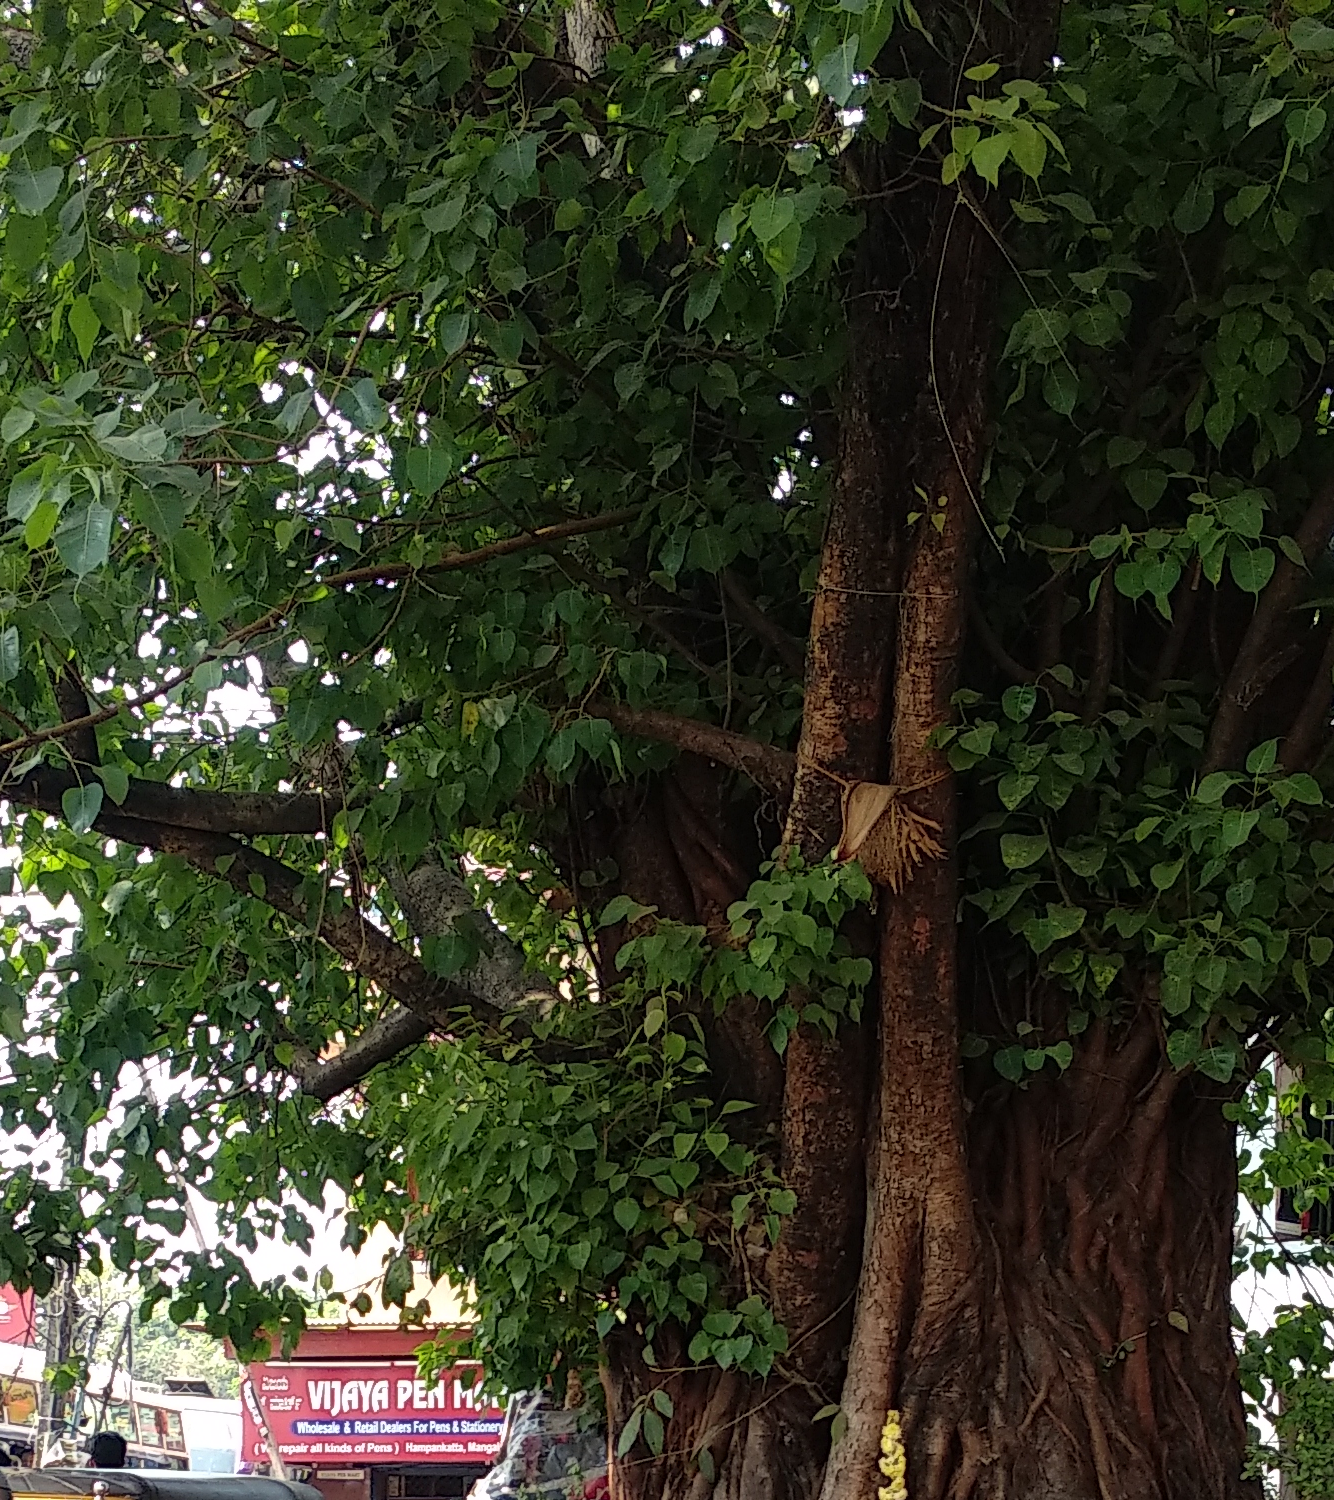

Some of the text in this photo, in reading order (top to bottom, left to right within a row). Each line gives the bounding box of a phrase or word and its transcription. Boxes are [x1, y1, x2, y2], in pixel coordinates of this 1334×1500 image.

[306, 1379, 390, 1416] VIJAYA
[396, 1379, 445, 1411] PEN
[297, 1420, 505, 1436] Wholesale & Retail Dealers For Pens & Stationery
[278, 1443, 309, 1456] repair
[310, 1443, 323, 1454] all
[324, 1442, 353, 1454] kinds
[355, 1442, 366, 1454] of
[405, 1442, 466, 1455] Hampankatta,
